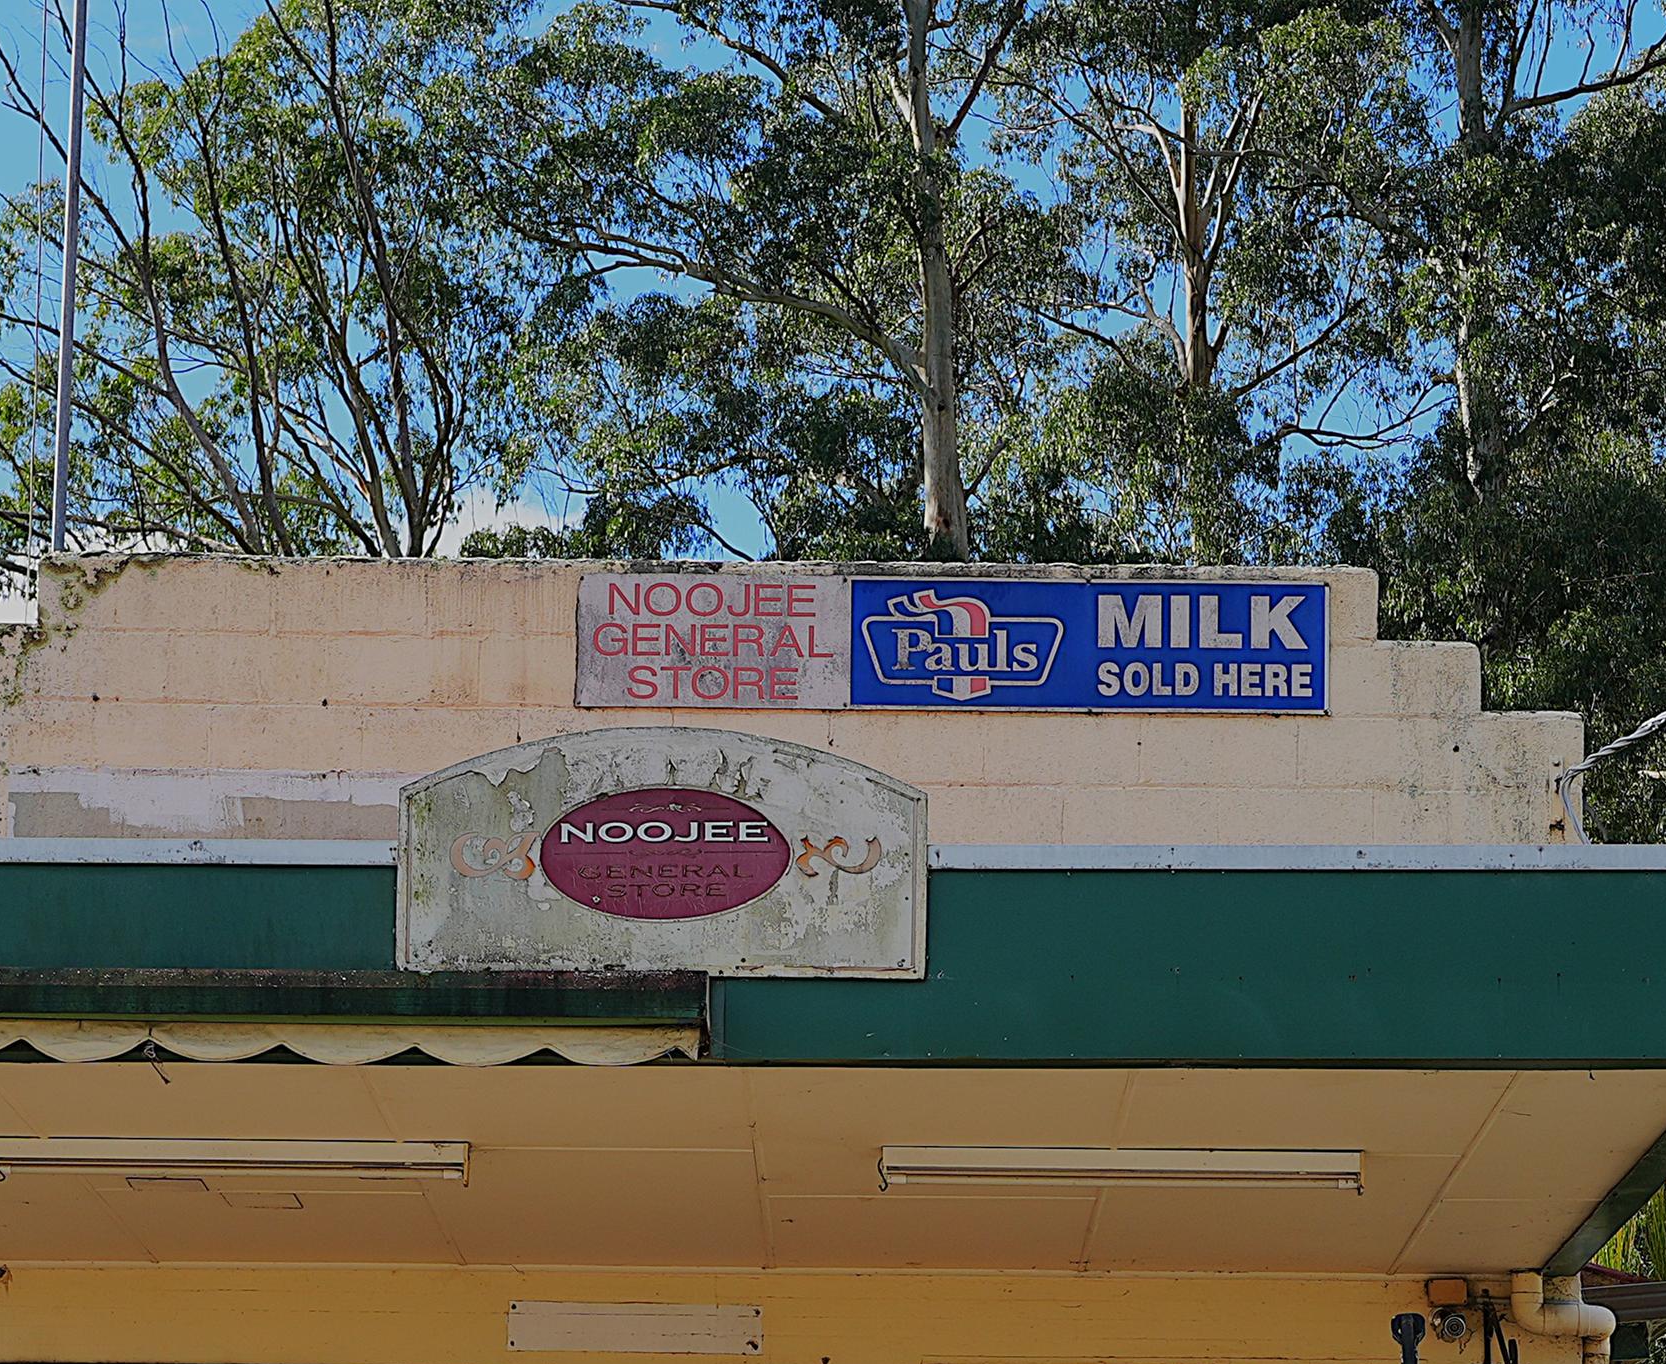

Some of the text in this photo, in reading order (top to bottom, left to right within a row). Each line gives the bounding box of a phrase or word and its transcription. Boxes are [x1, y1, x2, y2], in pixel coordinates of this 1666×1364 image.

[609, 583, 815, 617] NOOJEE
[1097, 594, 1309, 650] MILK
[593, 624, 833, 660] GENERAL
[891, 627, 1039, 673] Pauls
[626, 666, 799, 701] STORE
[1097, 662, 1313, 698] SOLD HERE
[559, 820, 771, 844] NOOJEE
[579, 863, 754, 879] GENERAL
[607, 883, 727, 899] STORE
